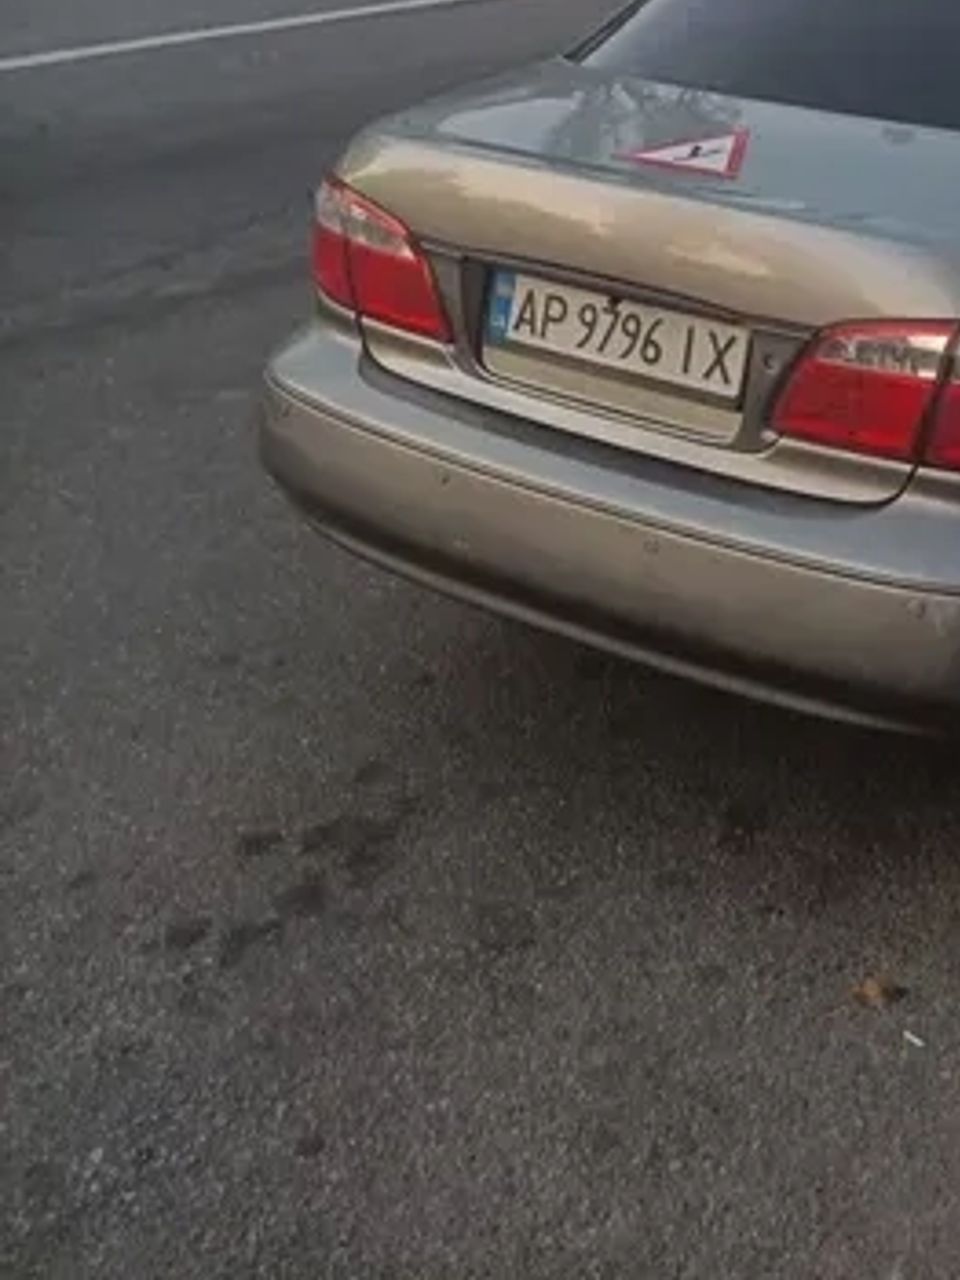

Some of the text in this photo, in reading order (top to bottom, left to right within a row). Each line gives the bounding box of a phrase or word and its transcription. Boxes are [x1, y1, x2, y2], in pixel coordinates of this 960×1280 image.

[513, 290, 736, 384] AP 9796 IX
